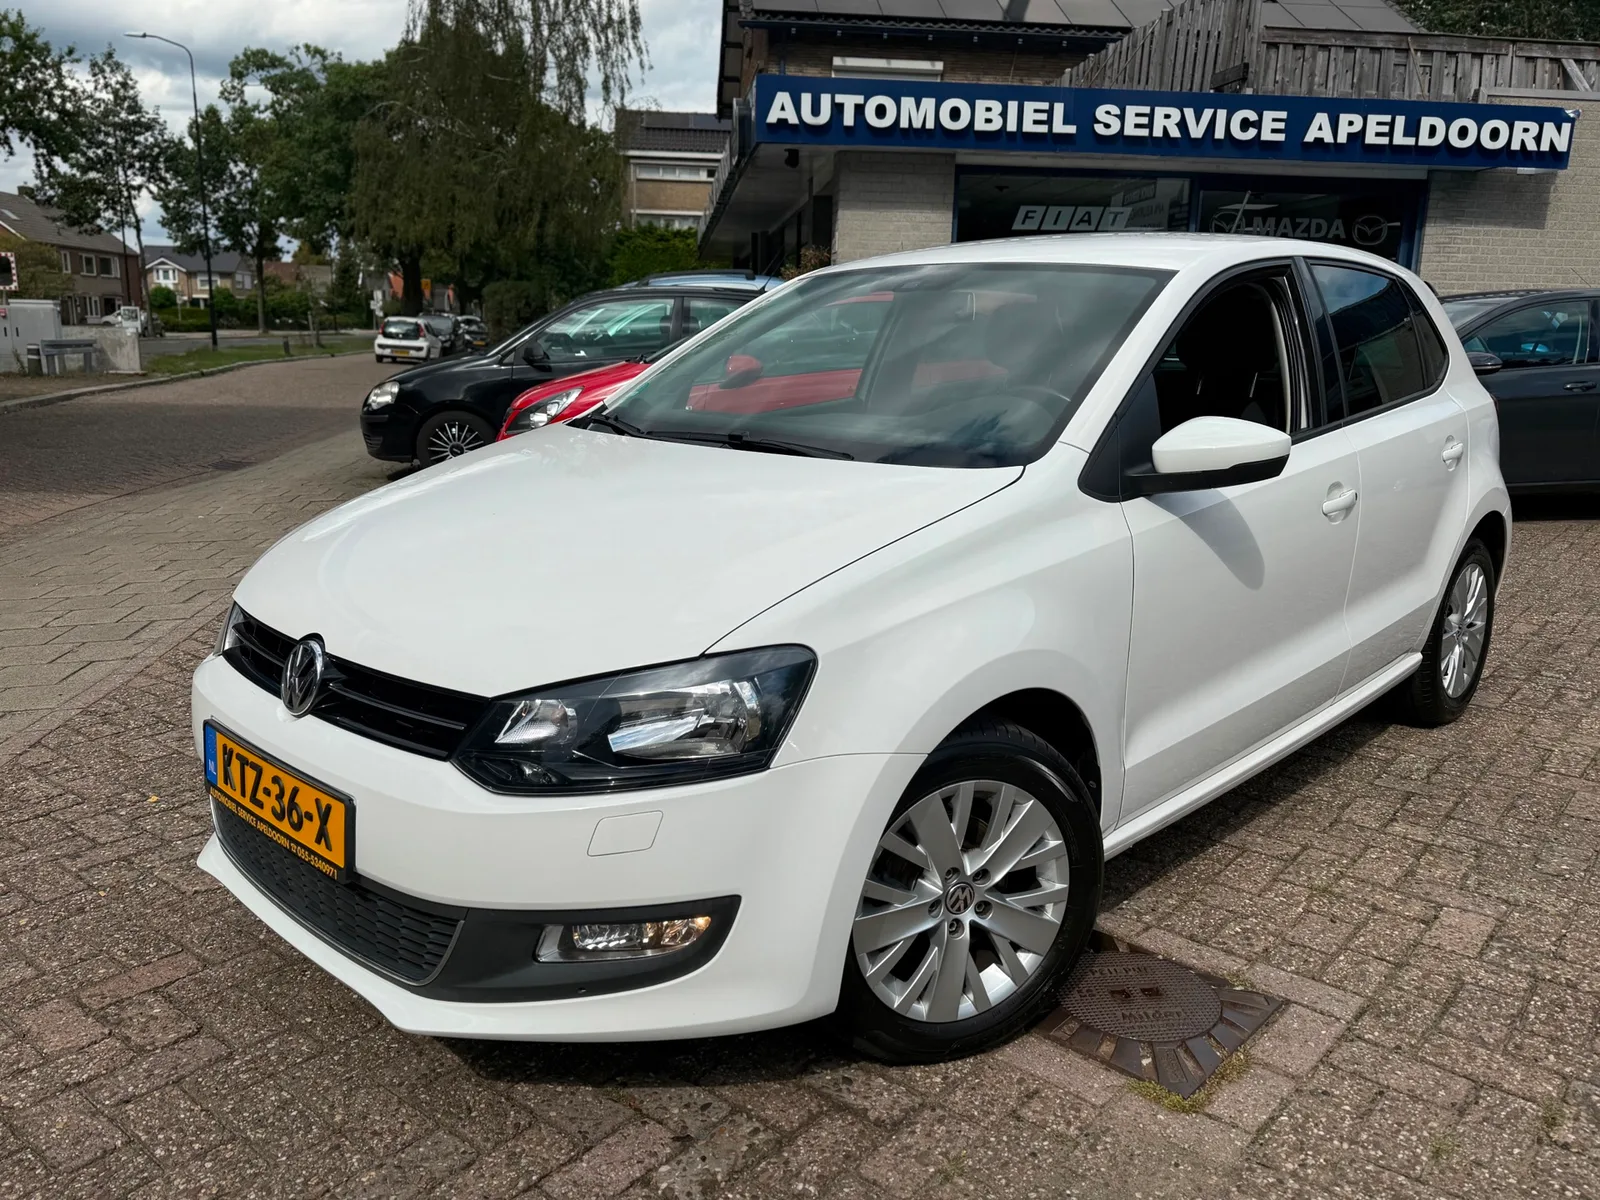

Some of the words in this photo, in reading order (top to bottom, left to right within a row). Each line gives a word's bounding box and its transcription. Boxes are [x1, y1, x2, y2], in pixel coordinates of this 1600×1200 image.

[765, 91, 1077, 135] AUTOMOBIEL
[1093, 104, 1288, 142] SERVICE
[1303, 112, 1572, 153] APELDOORN
[1018, 208, 1127, 228] FIAT
[1252, 216, 1347, 239] MAZDA
[208, 758, 217, 776] NL
[222, 743, 333, 852] KTZ-36-X
[209, 787, 238, 814] AUTOMOBIEL
[237, 806, 257, 827] SERVICE
[256, 820, 291, 849] APELDOORN
[296, 846, 338, 881] 055-5340971
